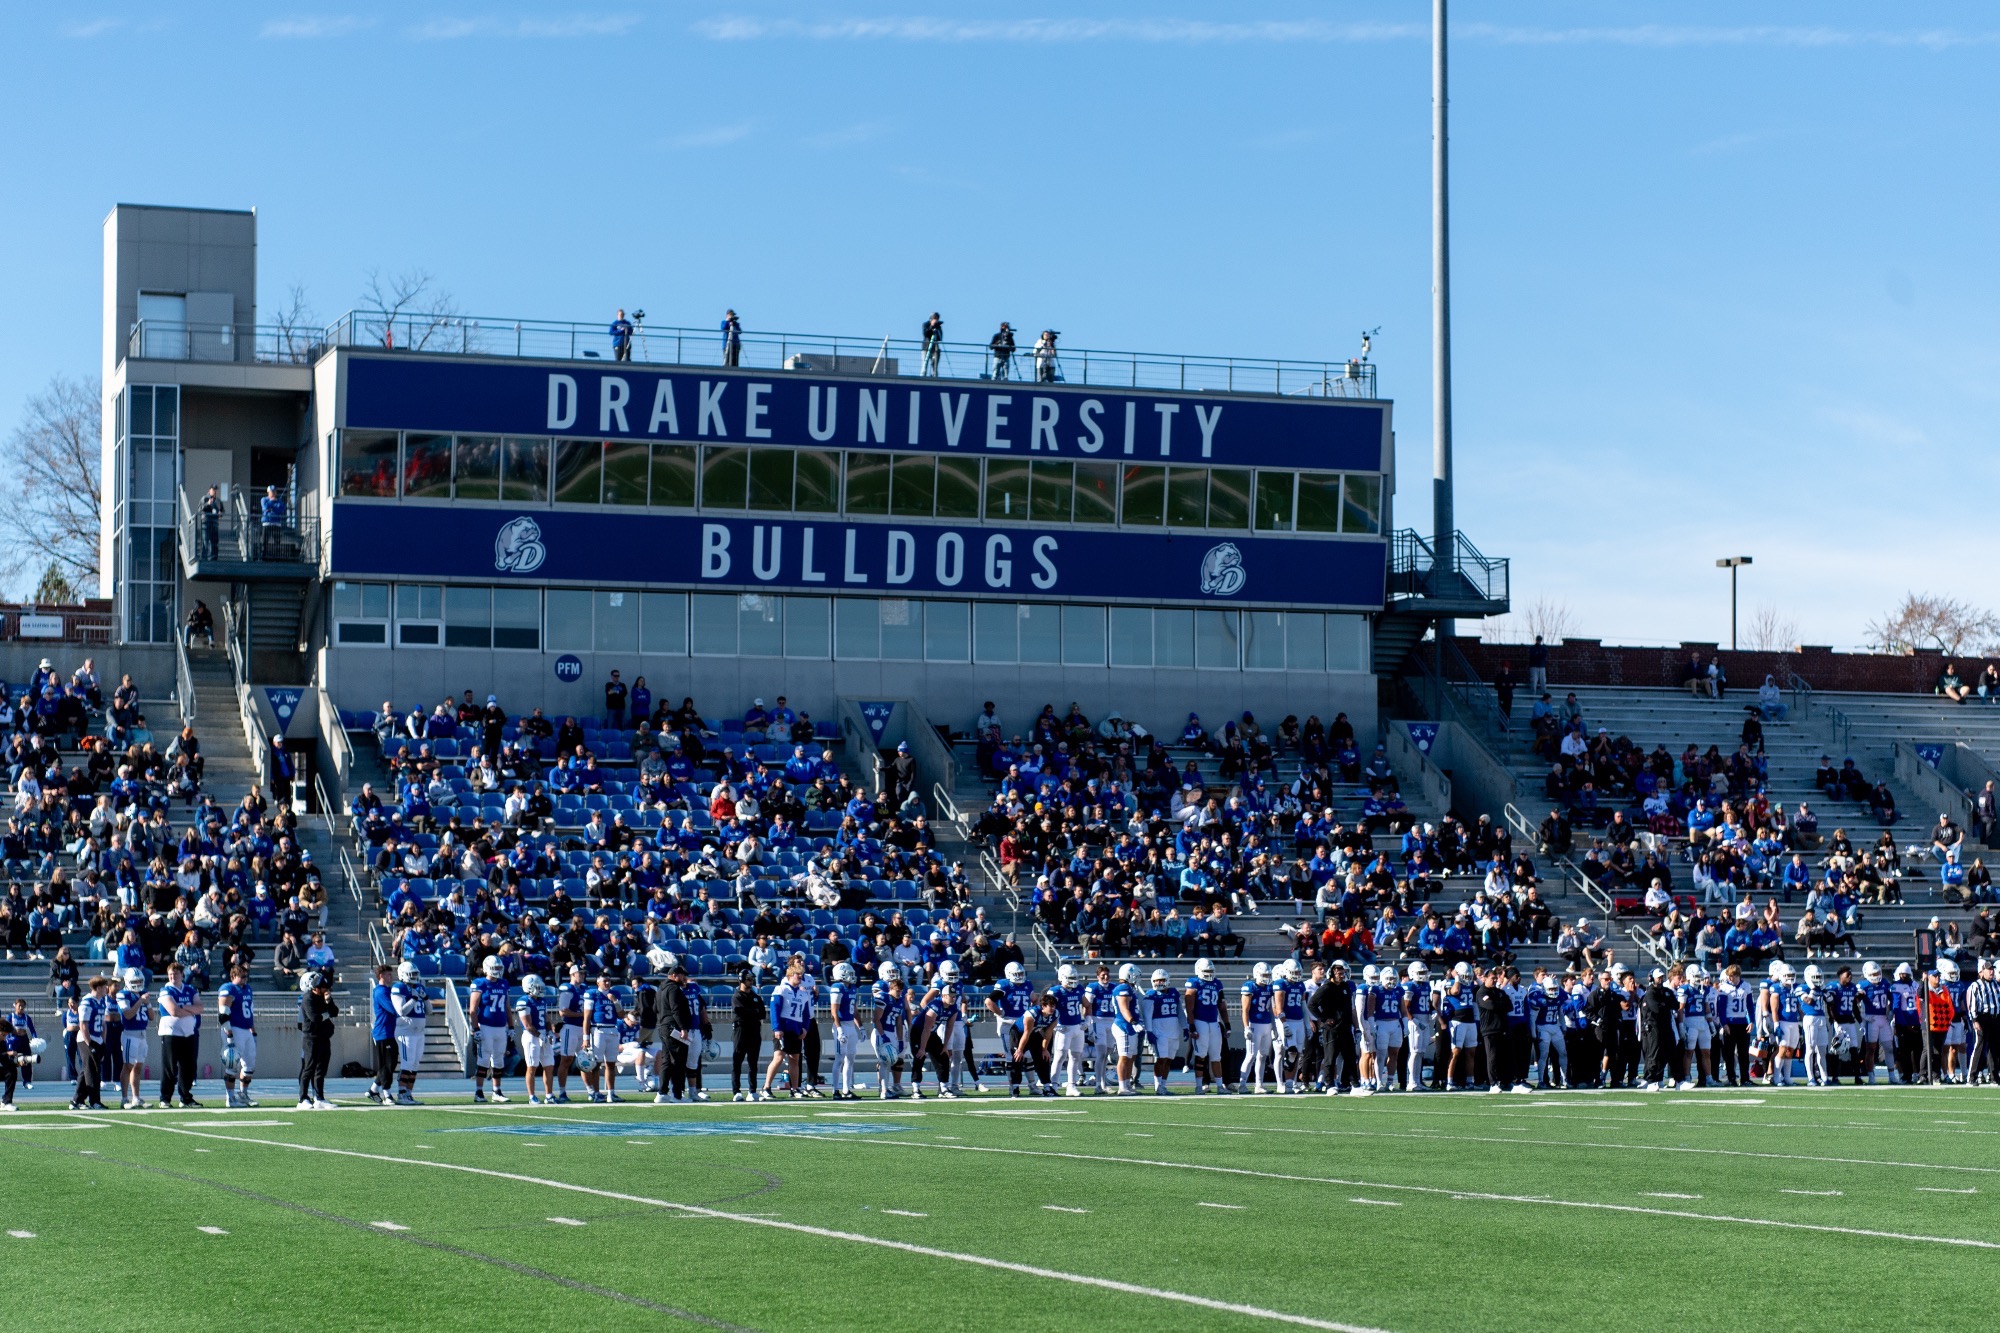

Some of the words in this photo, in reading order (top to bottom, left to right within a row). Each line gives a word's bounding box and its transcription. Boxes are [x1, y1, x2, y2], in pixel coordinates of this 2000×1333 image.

[547, 373, 773, 438] DRAKE
[808, 385, 1223, 458] UNIVERSITY
[701, 523, 1059, 590] BULLDOGS
[557, 662, 580, 675] PFM
[274, 694, 281, 704] V
[285, 694, 295, 704] W
[867, 707, 876, 716] W
[880, 708, 886, 717] X
[1415, 728, 1421, 737] X
[1426, 729, 1432, 738] Y
[1922, 749, 1928, 758] Y
[1921, 932, 1930, 955] 1
[490, 995, 506, 1012] 74
[1012, 995, 1030, 1011] 75
[1202, 989, 1218, 1006] 50
[1459, 993, 1474, 1007] 32
[1785, 997, 1798, 1012] 15
[1840, 996, 1855, 1011] 35
[1873, 994, 1888, 1009] 40
[242, 1000, 254, 1019] 6
[604, 1004, 613, 1020] 3
[790, 1002, 803, 1020] 71
[1381, 1000, 1399, 1013] 46
[1696, 1000, 1703, 1012] 5
[1733, 999, 1746, 1013] 31
[538, 1010, 545, 1027] 5
